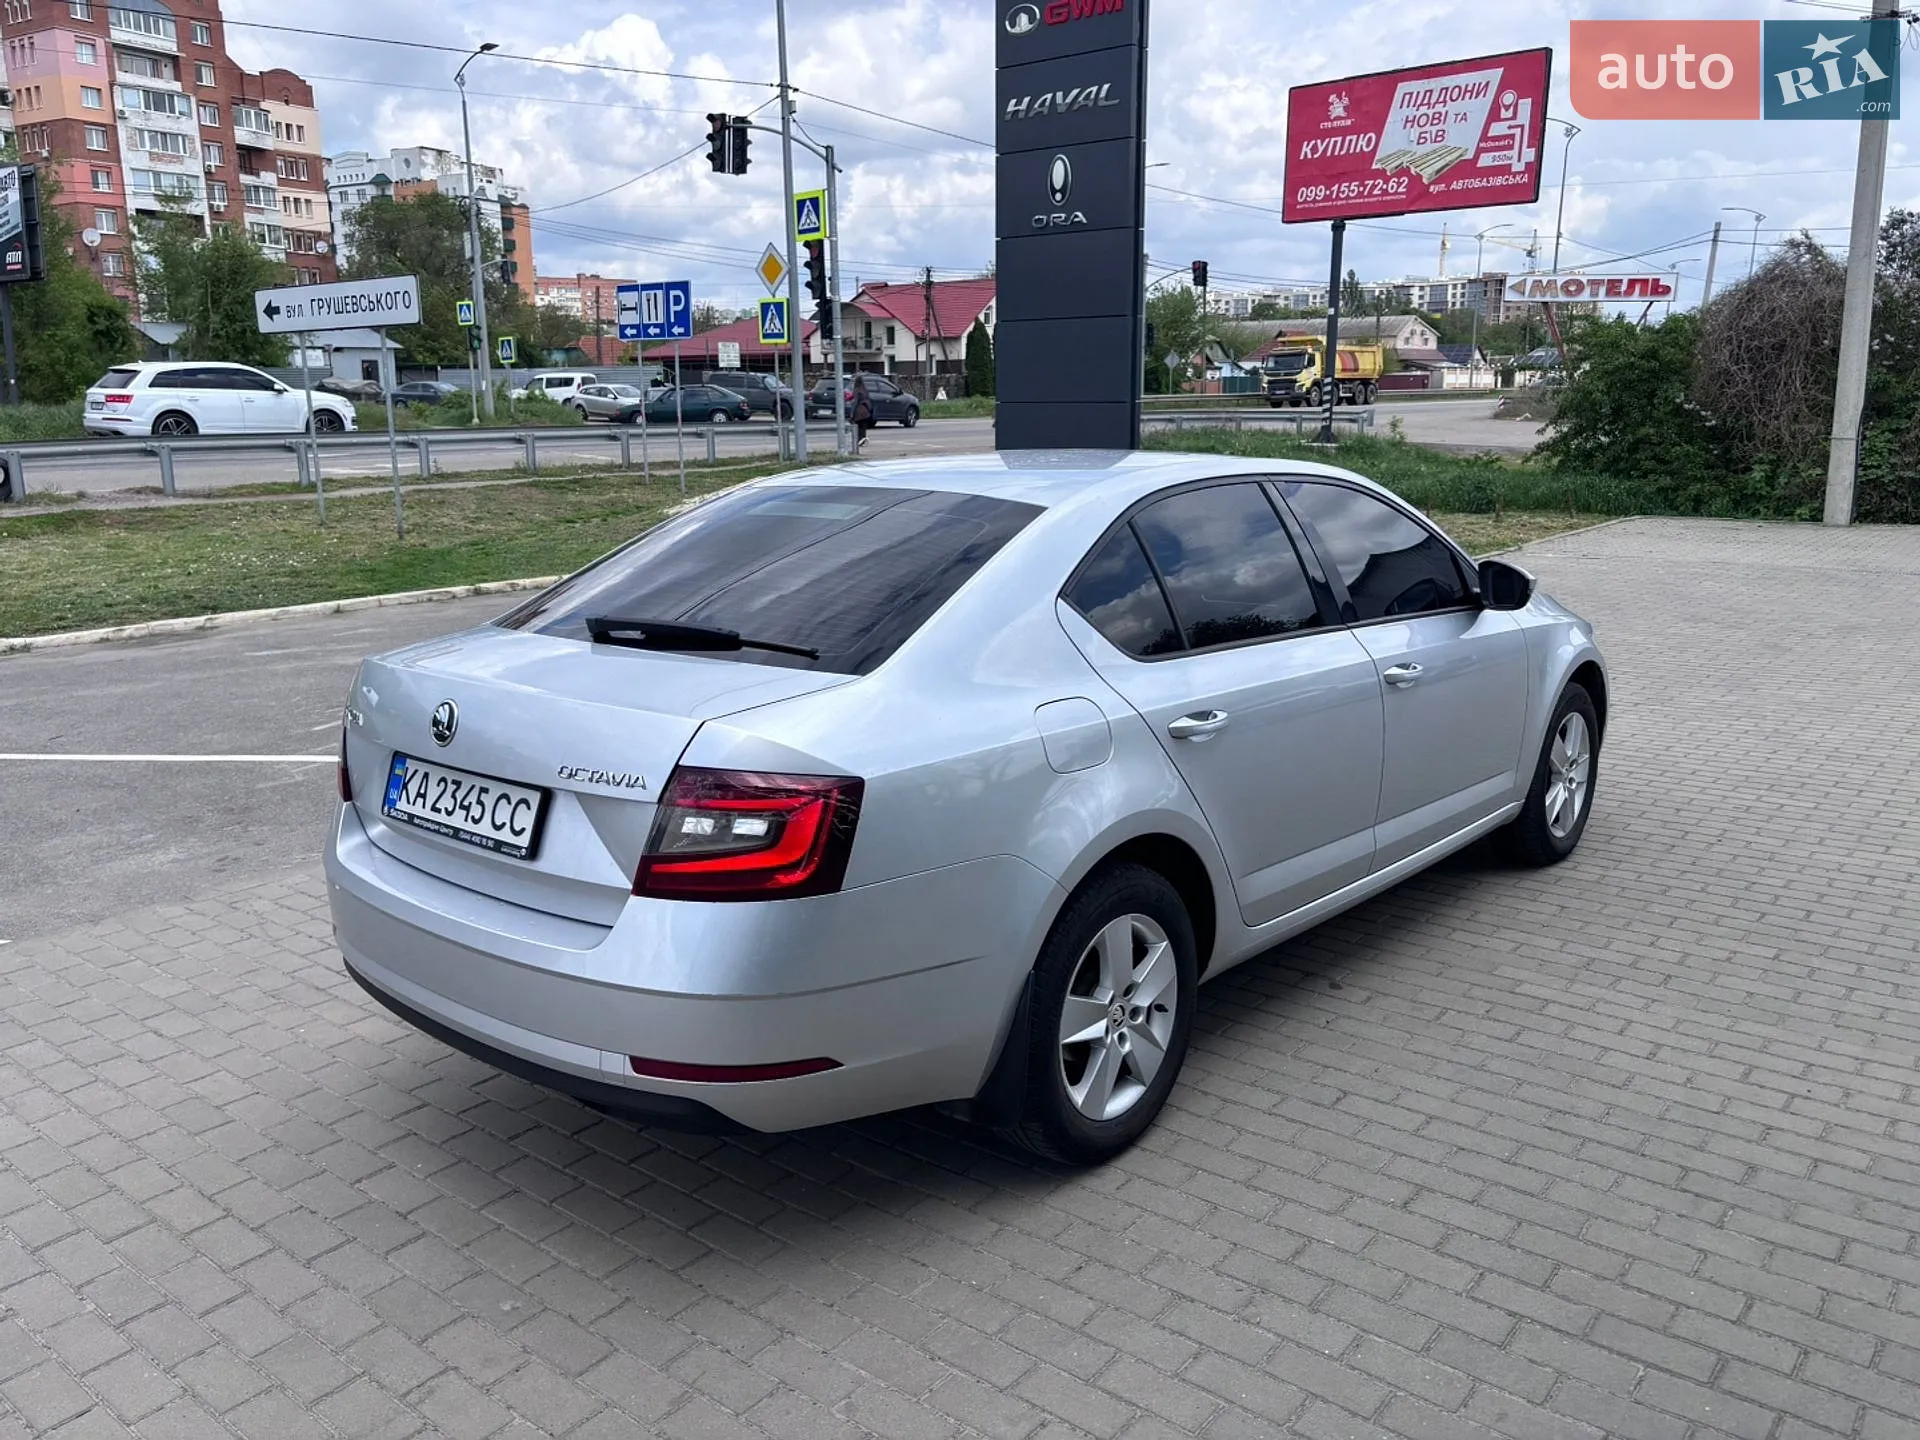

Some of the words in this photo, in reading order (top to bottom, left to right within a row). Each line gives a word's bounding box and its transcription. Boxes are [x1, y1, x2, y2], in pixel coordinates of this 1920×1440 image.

[1045, 0, 1125, 25] GWM
[1004, 82, 1121, 121] HAVAL
[1400, 80, 1490, 111] ПІДДОНИ
[1403, 111, 1448, 130] НОВІ
[1453, 112, 1468, 124] ТА
[1300, 132, 1376, 160] КУПЛЮ
[1450, 173, 1528, 190] АВТОБАЗІВСЬКА
[1031, 211, 1087, 228] ORA
[1528, 278, 1672, 298] МОТЕЛЬ
[310, 290, 412, 317] ГРУШЕВСЬКОГО
[669, 289, 685, 323] P
[558, 764, 647, 790] OCTAVIA
[399, 766, 430, 809] KA
[430, 776, 490, 825] 2345
[491, 792, 532, 837] CC
